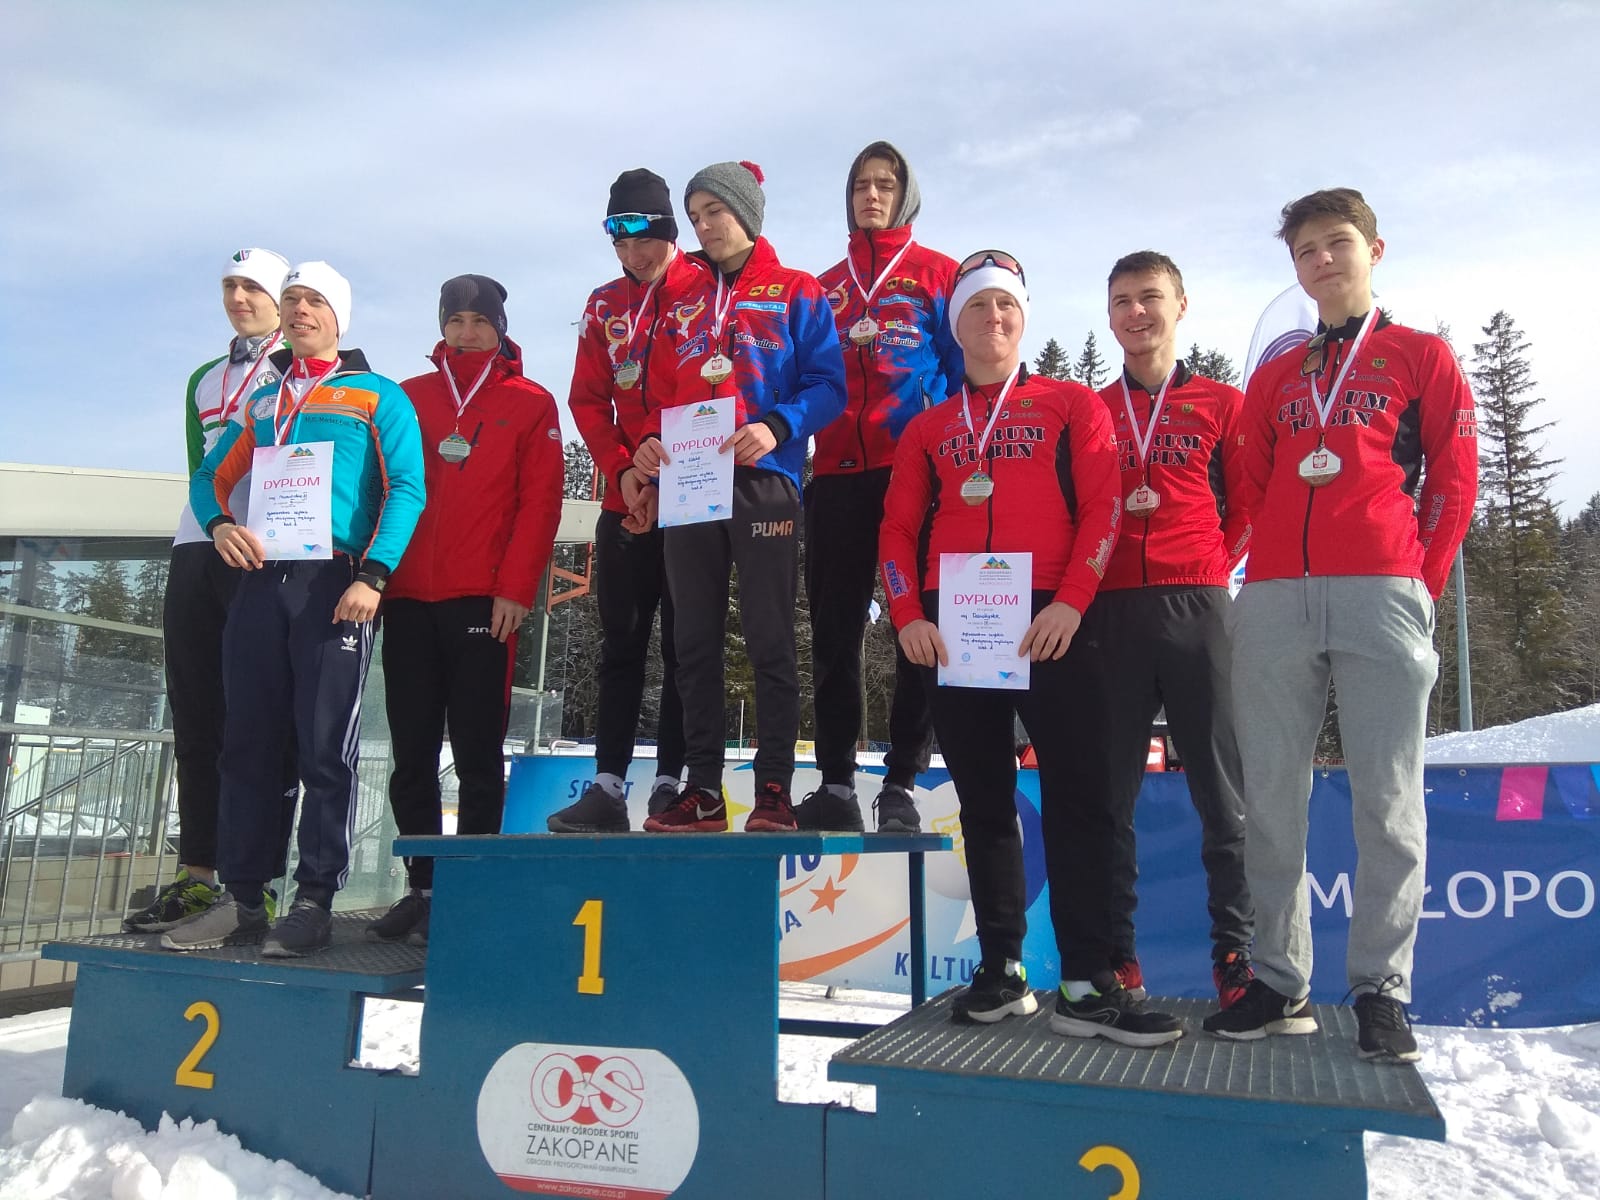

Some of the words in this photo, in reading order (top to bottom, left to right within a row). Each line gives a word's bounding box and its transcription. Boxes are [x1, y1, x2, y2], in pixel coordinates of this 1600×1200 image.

[672, 435, 724, 454] DYPLOM
[263, 476, 320, 490] DYPLOM
[751, 520, 793, 537] PUMA
[954, 594, 1019, 606] DYPLOM
[572, 899, 605, 996] 1
[175, 1001, 220, 1090] 2
[527, 1123, 570, 1134] CENTRALNY
[572, 1126, 608, 1137] OŚRODEK
[610, 1129, 639, 1140] SPORTU
[526, 1134, 639, 1164] ZAKOPANE
[536, 1183, 626, 1199] www.zakopane.cos.pl
